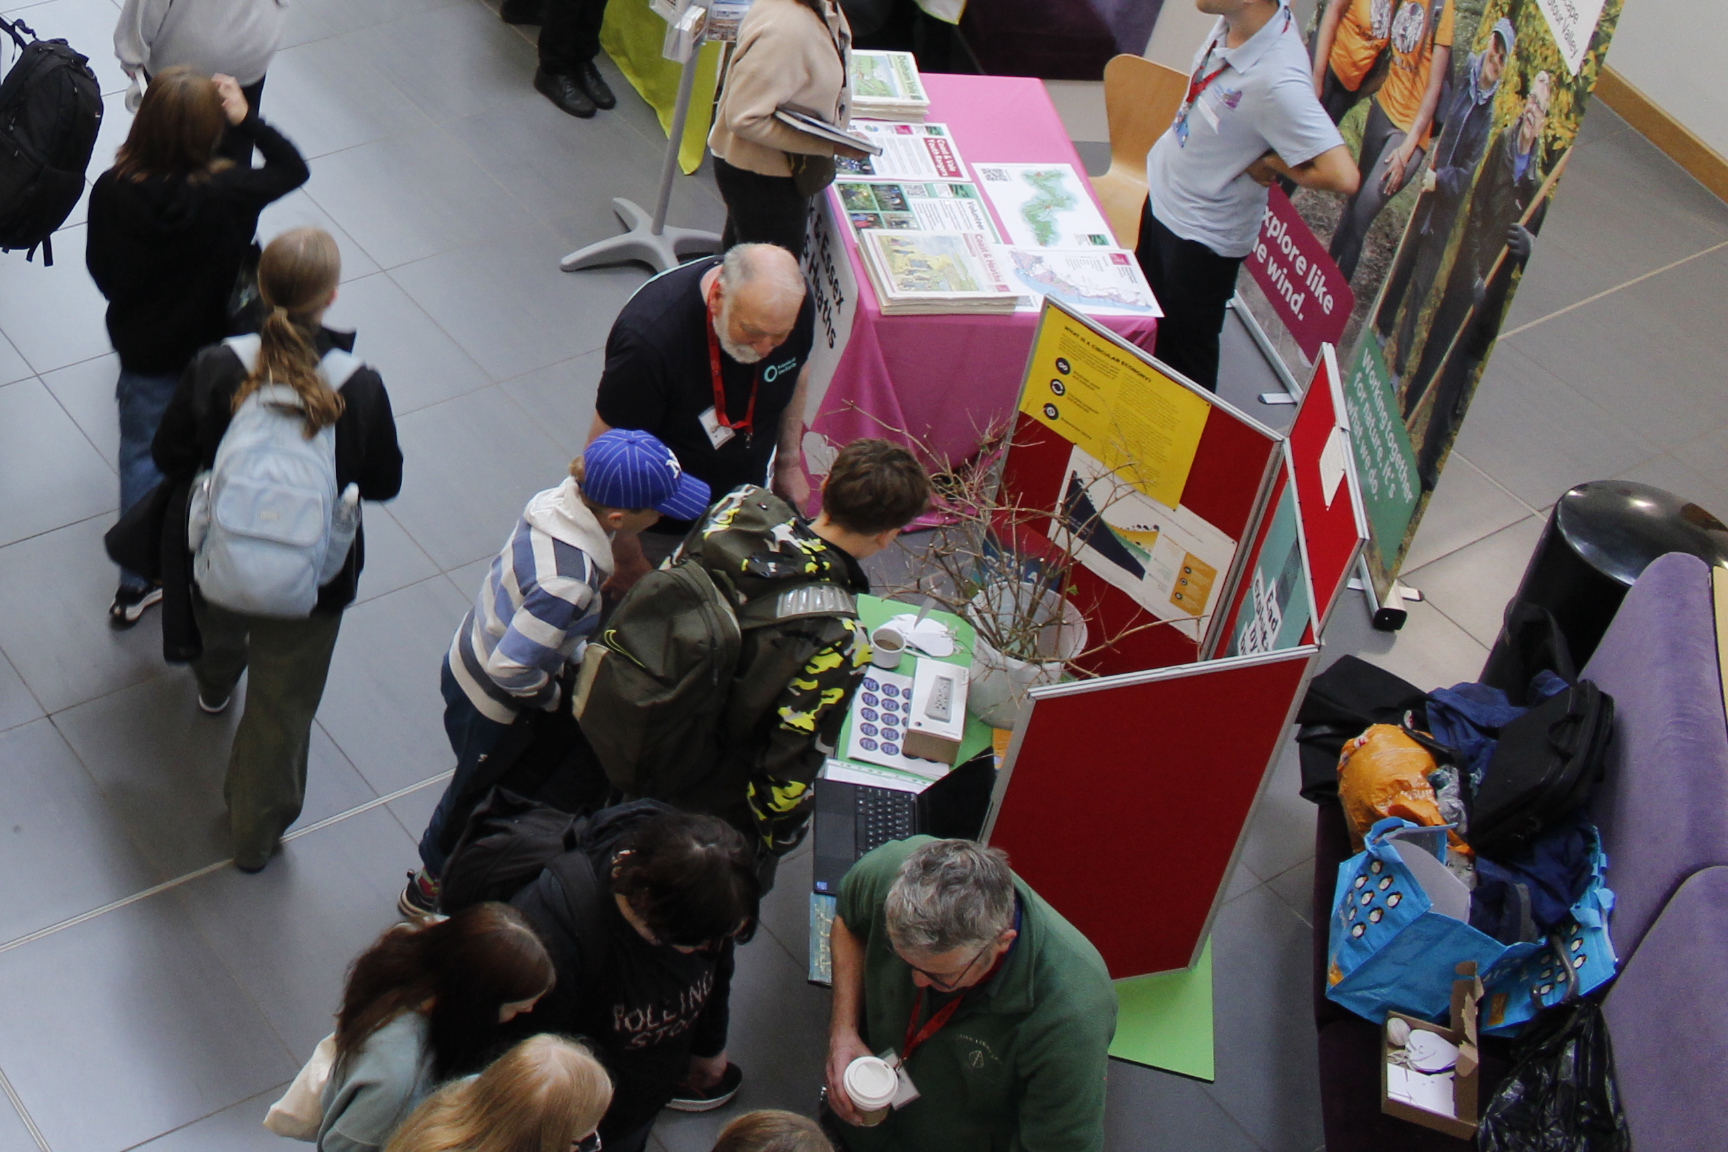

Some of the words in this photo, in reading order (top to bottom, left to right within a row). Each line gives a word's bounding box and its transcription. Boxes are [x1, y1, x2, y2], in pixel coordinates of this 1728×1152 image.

[1562, 17, 1579, 60] Valley
[936, 139, 949, 156] Coast
[967, 201, 985, 231] Volunteer
[974, 233, 987, 254] Coast
[986, 258, 1003, 284] Heaths
[808, 252, 836, 350] Heaths
[821, 230, 845, 315] Essex
[1262, 205, 1307, 276] xplore
[1306, 264, 1334, 316] like
[1267, 256, 1305, 322] wind.
[1347, 397, 1363, 445] what
[1359, 440, 1371, 471] we
[1368, 468, 1379, 502] do.
[1354, 372, 1367, 403] for
[1363, 402, 1383, 468] nature.
[1382, 460, 1396, 499] It's
[1362, 348, 1389, 431] Working
[1385, 421, 1414, 504] together
